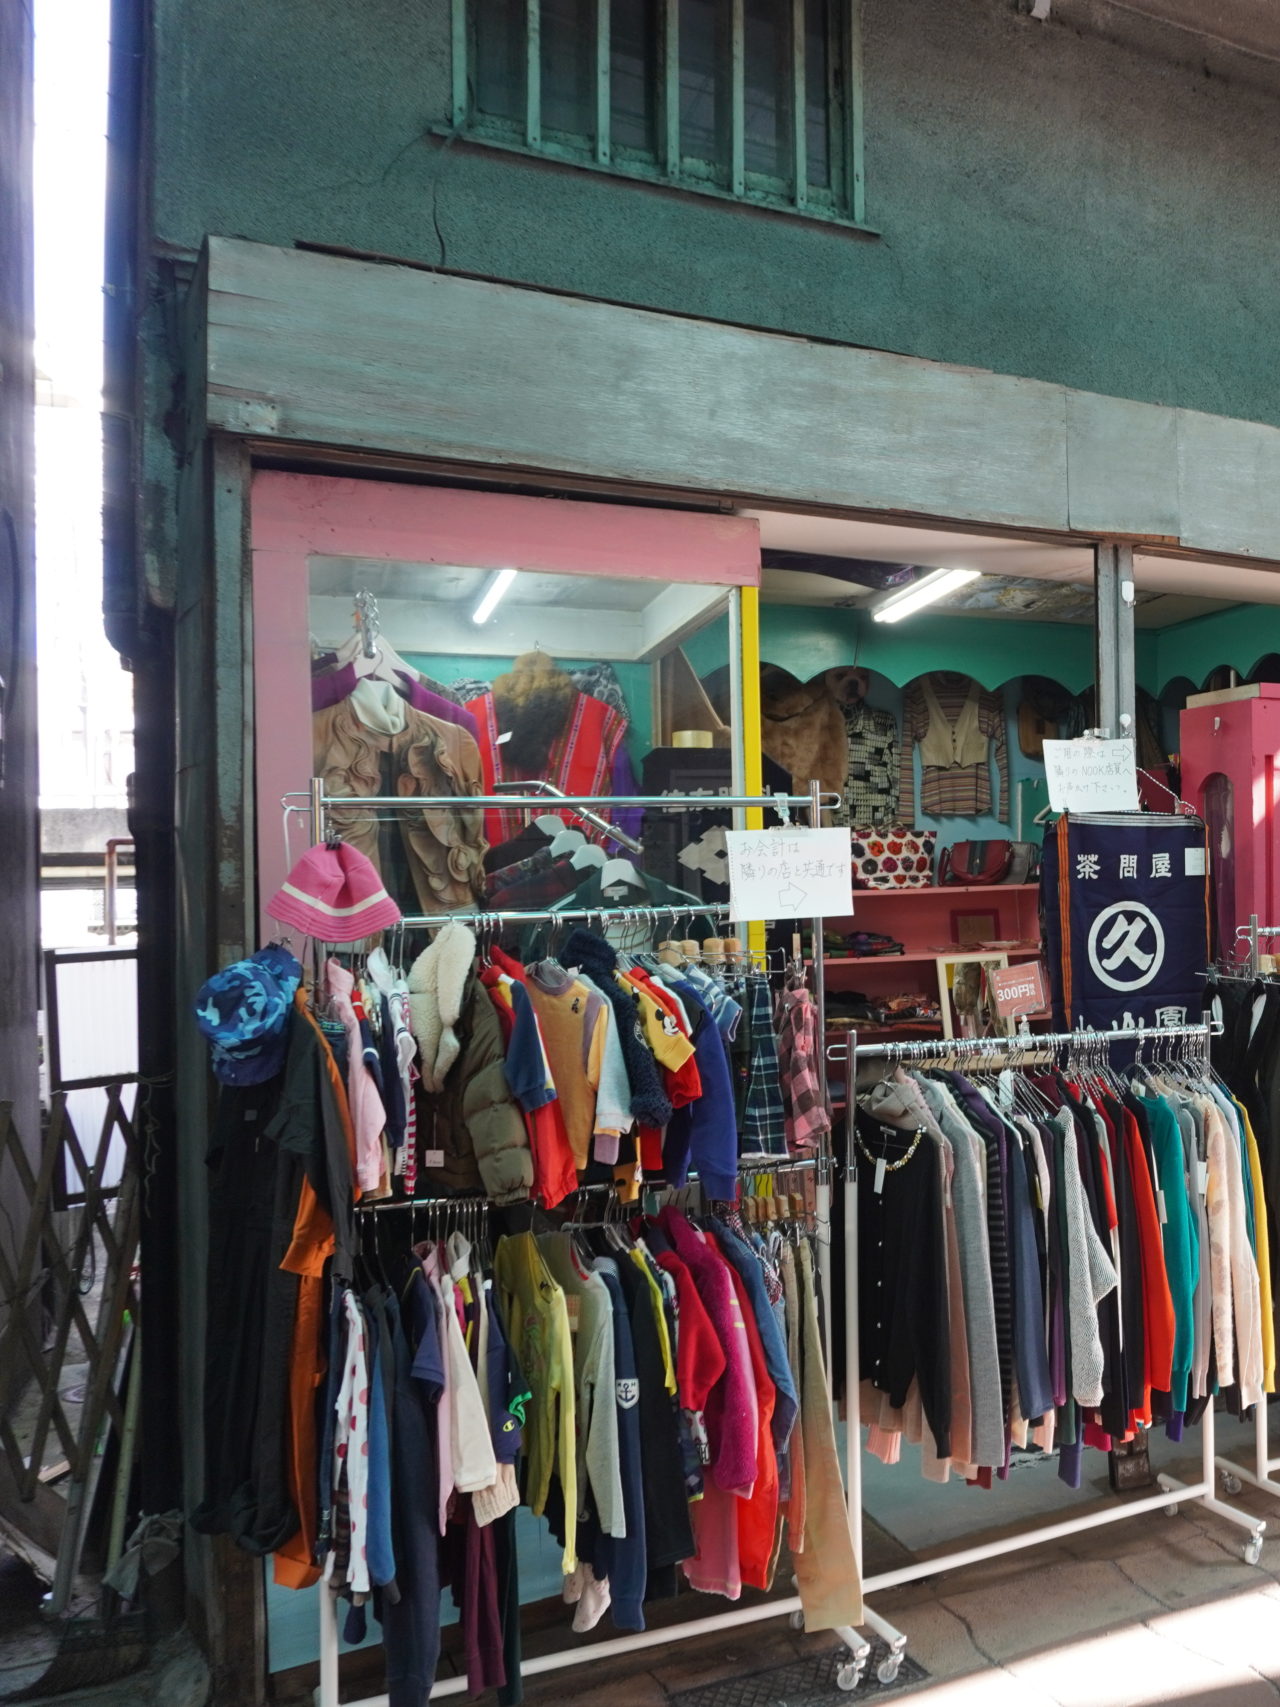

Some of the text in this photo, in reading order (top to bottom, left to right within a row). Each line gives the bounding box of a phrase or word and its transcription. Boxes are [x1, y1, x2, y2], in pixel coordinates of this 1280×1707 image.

[740, 839, 800, 858] お会計は
[1075, 853, 1173, 880] 茶問屋
[1099, 911, 1158, 974] 久
